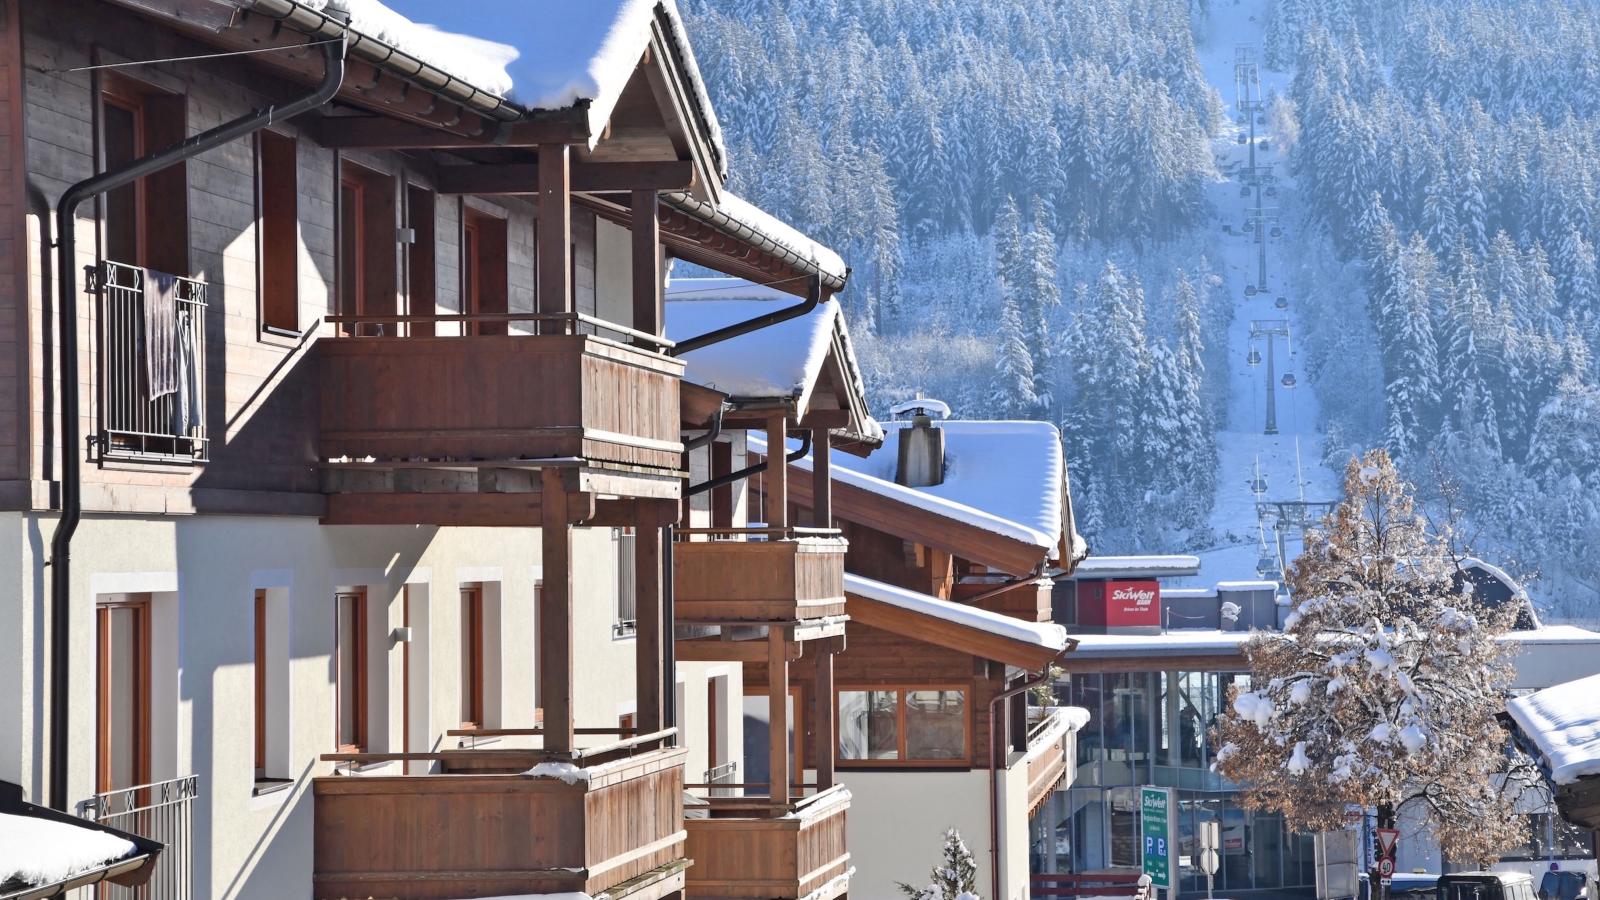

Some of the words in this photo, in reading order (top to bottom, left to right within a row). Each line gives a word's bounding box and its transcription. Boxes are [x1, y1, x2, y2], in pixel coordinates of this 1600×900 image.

[1112, 588, 1154, 600] SkiWelt
[1144, 795, 1165, 808] SkiWelt
[1382, 862, 1390, 872] 40
